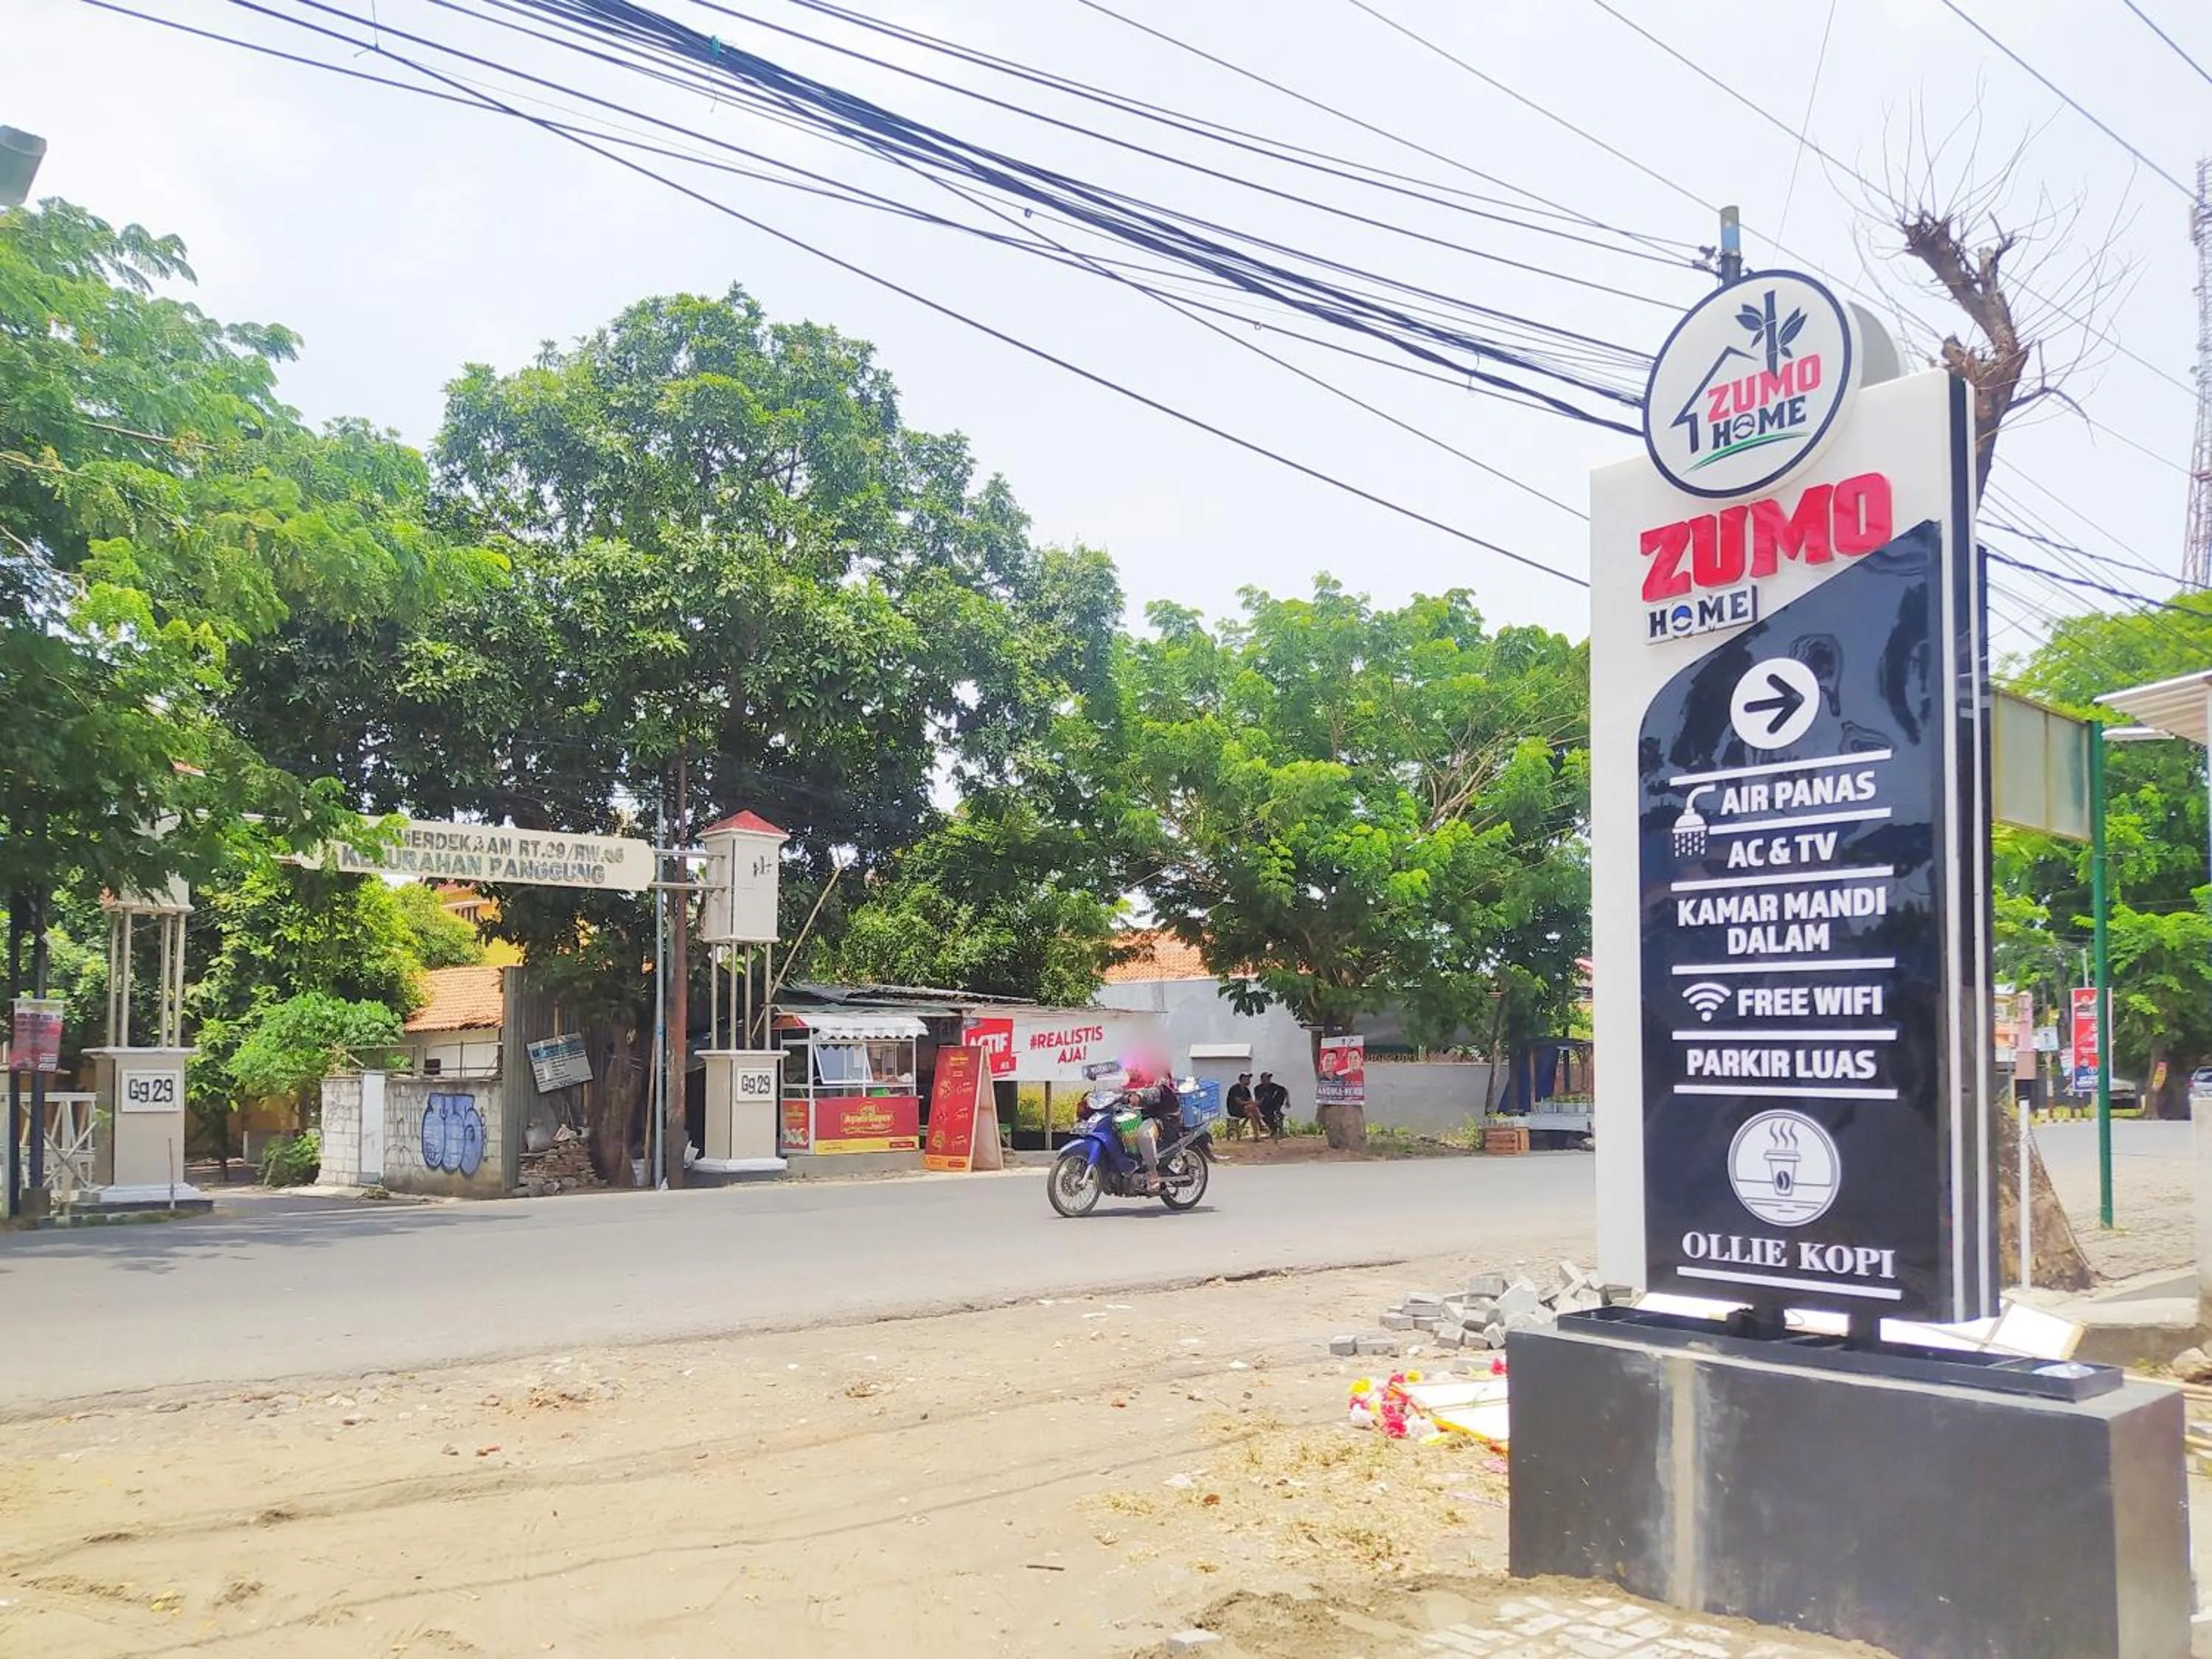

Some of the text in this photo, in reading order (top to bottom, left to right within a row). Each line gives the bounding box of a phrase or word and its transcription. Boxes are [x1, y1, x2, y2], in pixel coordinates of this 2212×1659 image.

[1707, 354, 1821, 423] ZUMO
[1712, 396, 1806, 451] HOME
[1640, 472, 1893, 603] ZUMO
[1649, 589, 1749, 638] HOME
[1720, 771, 1877, 815] AIR PANAS
[375, 828, 511, 855] MERDEKAAN
[1727, 830, 1838, 869] AC & TV
[341, 844, 606, 883] KURAHAN PANGGUNG
[1677, 886, 1887, 927] KAMAR MANDI
[1727, 923, 1830, 955] DALAM
[1737, 986, 1883, 1016] FREE WIFI
[1029, 1026, 1104, 1050] #REALISTIS
[1057, 1046, 1087, 1064] AJA!
[1686, 1049, 1877, 1080] PARKIR LUAS
[1682, 1231, 1896, 1279] OLLIE KOPI
